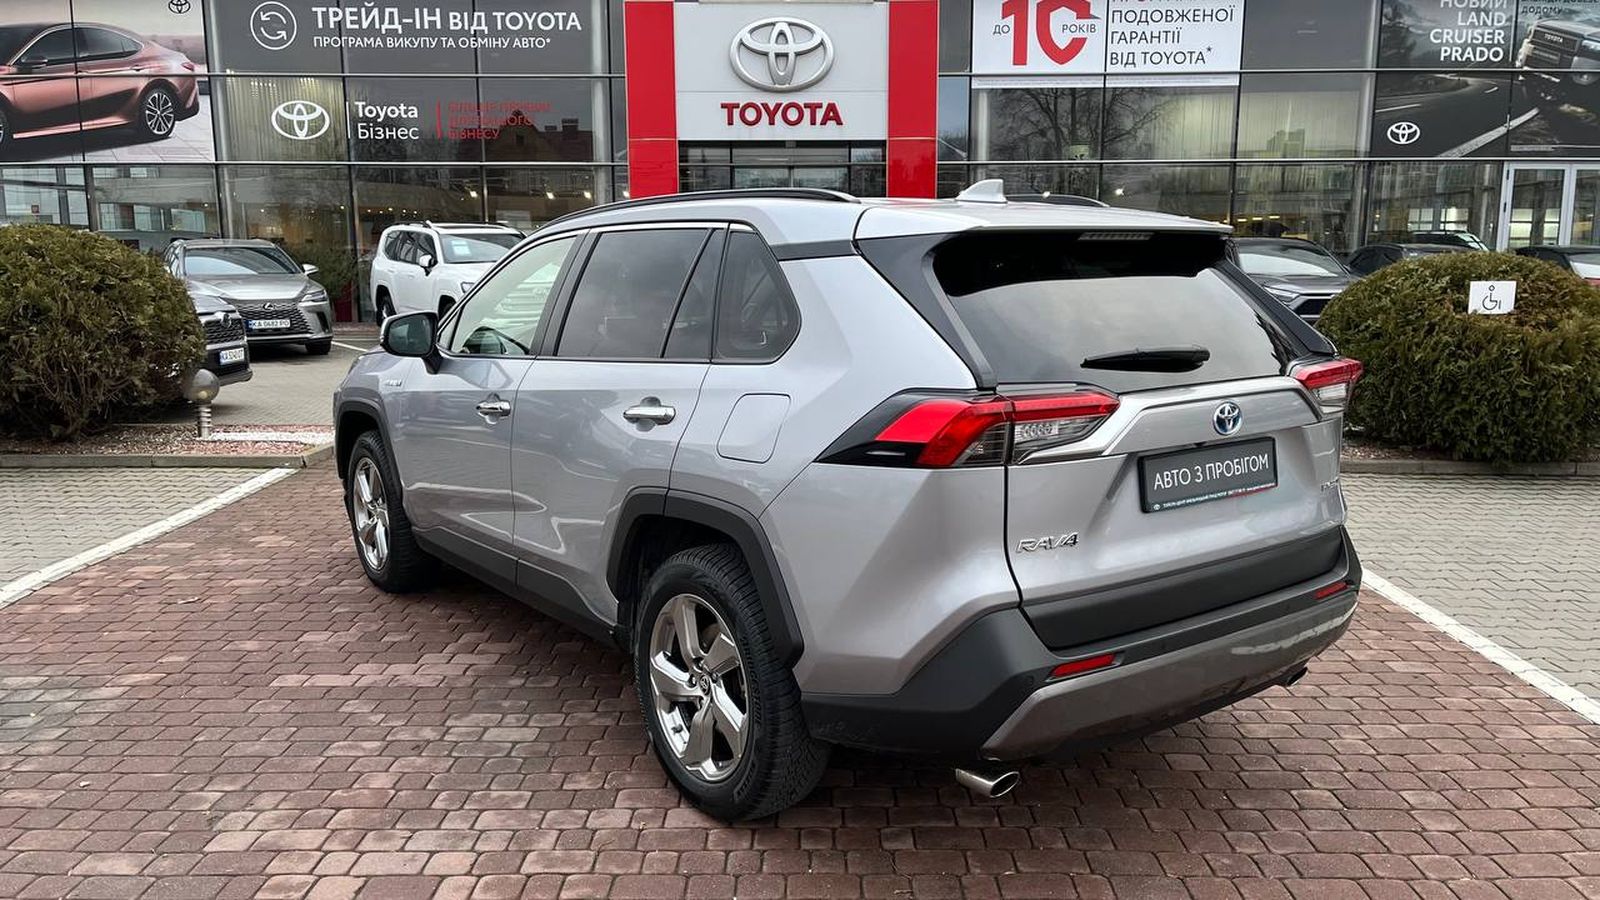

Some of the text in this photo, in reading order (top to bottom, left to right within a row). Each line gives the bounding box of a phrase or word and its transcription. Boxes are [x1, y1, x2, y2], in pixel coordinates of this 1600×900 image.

[311, 2, 582, 34] ТРЕЙД-ІН ВІД TOYOTA
[1111, 5, 1236, 26] ПОДОВЖЕНОЇ
[1457, 11, 1506, 26] LAND
[993, 24, 1011, 36] ДО
[1061, 23, 1097, 34] РОКІВ
[1110, 27, 1183, 45] ГАРАНТІЇ
[1429, 28, 1505, 44] CRUISER
[313, 37, 384, 49] ПРОГРАМА
[386, 37, 437, 49] ВИКУПУ
[440, 37, 456, 48] ТА
[458, 37, 510, 49] ОБМІНУ
[1109, 52, 1137, 68] ВІД
[1440, 47, 1504, 62] PRADO
[354, 101, 418, 122] Toyota
[720, 102, 844, 126] TOYOTA
[357, 123, 419, 140] Бізнес
[1154, 468, 1191, 491] АВТО
[1205, 453, 1269, 482] ПРОБІГОМ
[1015, 531, 1079, 554] RAV4
